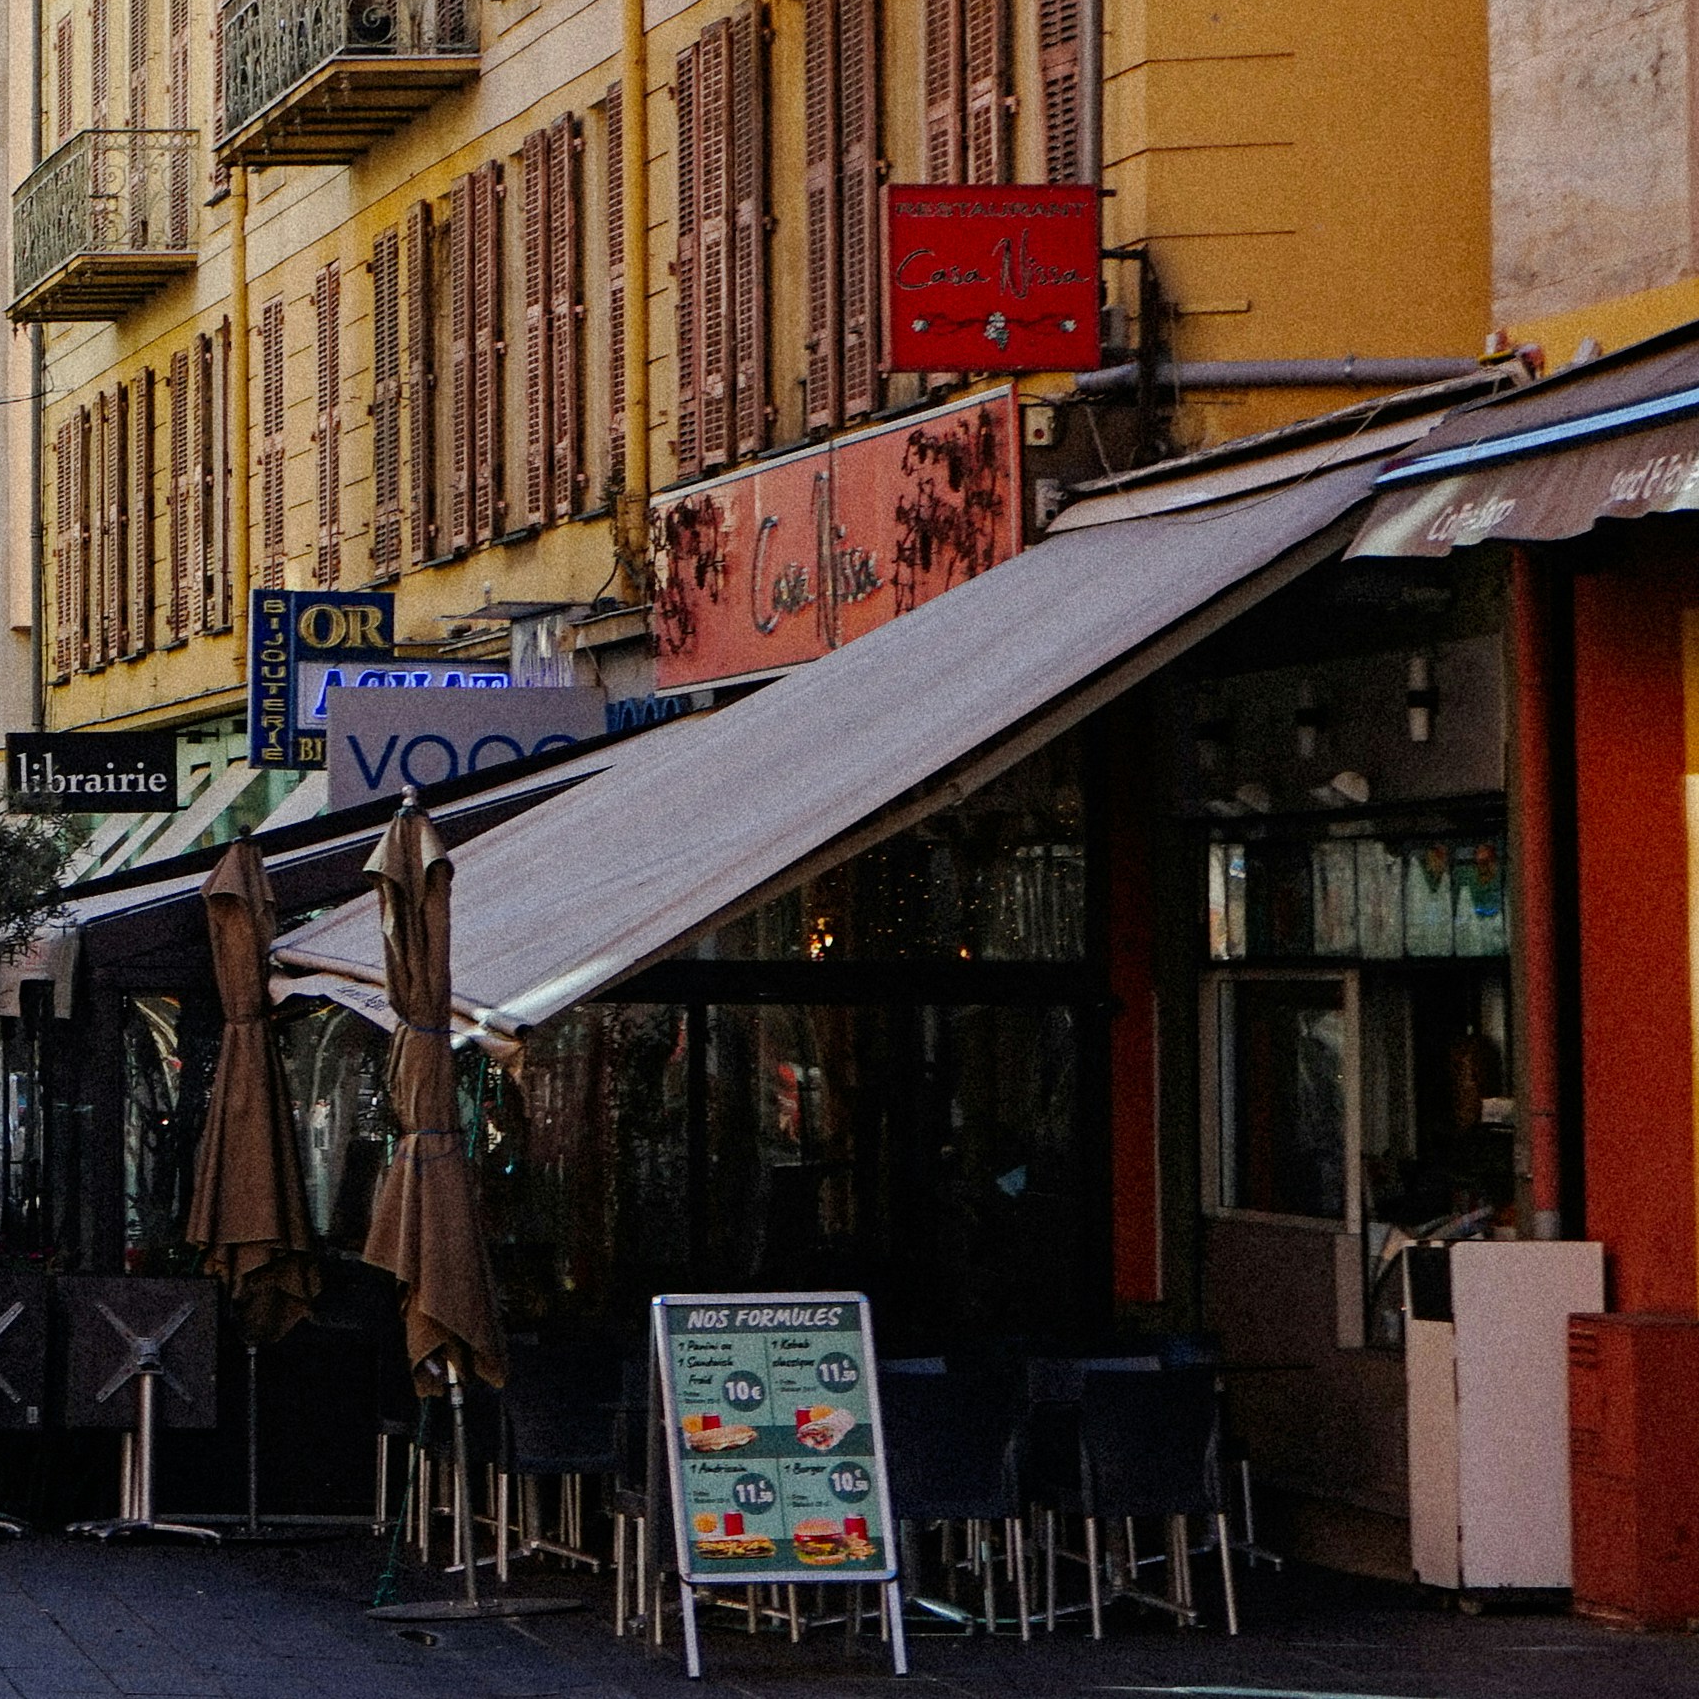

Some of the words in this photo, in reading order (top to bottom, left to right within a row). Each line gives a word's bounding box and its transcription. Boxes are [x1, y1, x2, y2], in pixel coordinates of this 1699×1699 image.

[895, 202, 1089, 218] RESTAURANT
[896, 249, 991, 290] Casa
[992, 228, 1089, 299] Nissa
[299, 604, 389, 649] OR
[261, 600, 287, 760] BIJOUTERIE
[16, 753, 168, 793] librairie
[687, 1309, 729, 1329] NOS
[735, 1307, 842, 1327] FORMULES
[687, 1340, 718, 1351] Panini
[781, 1338, 810, 1349] Kebab
[687, 1356, 734, 1368] Sandwich
[793, 1463, 827, 1475] Burger
